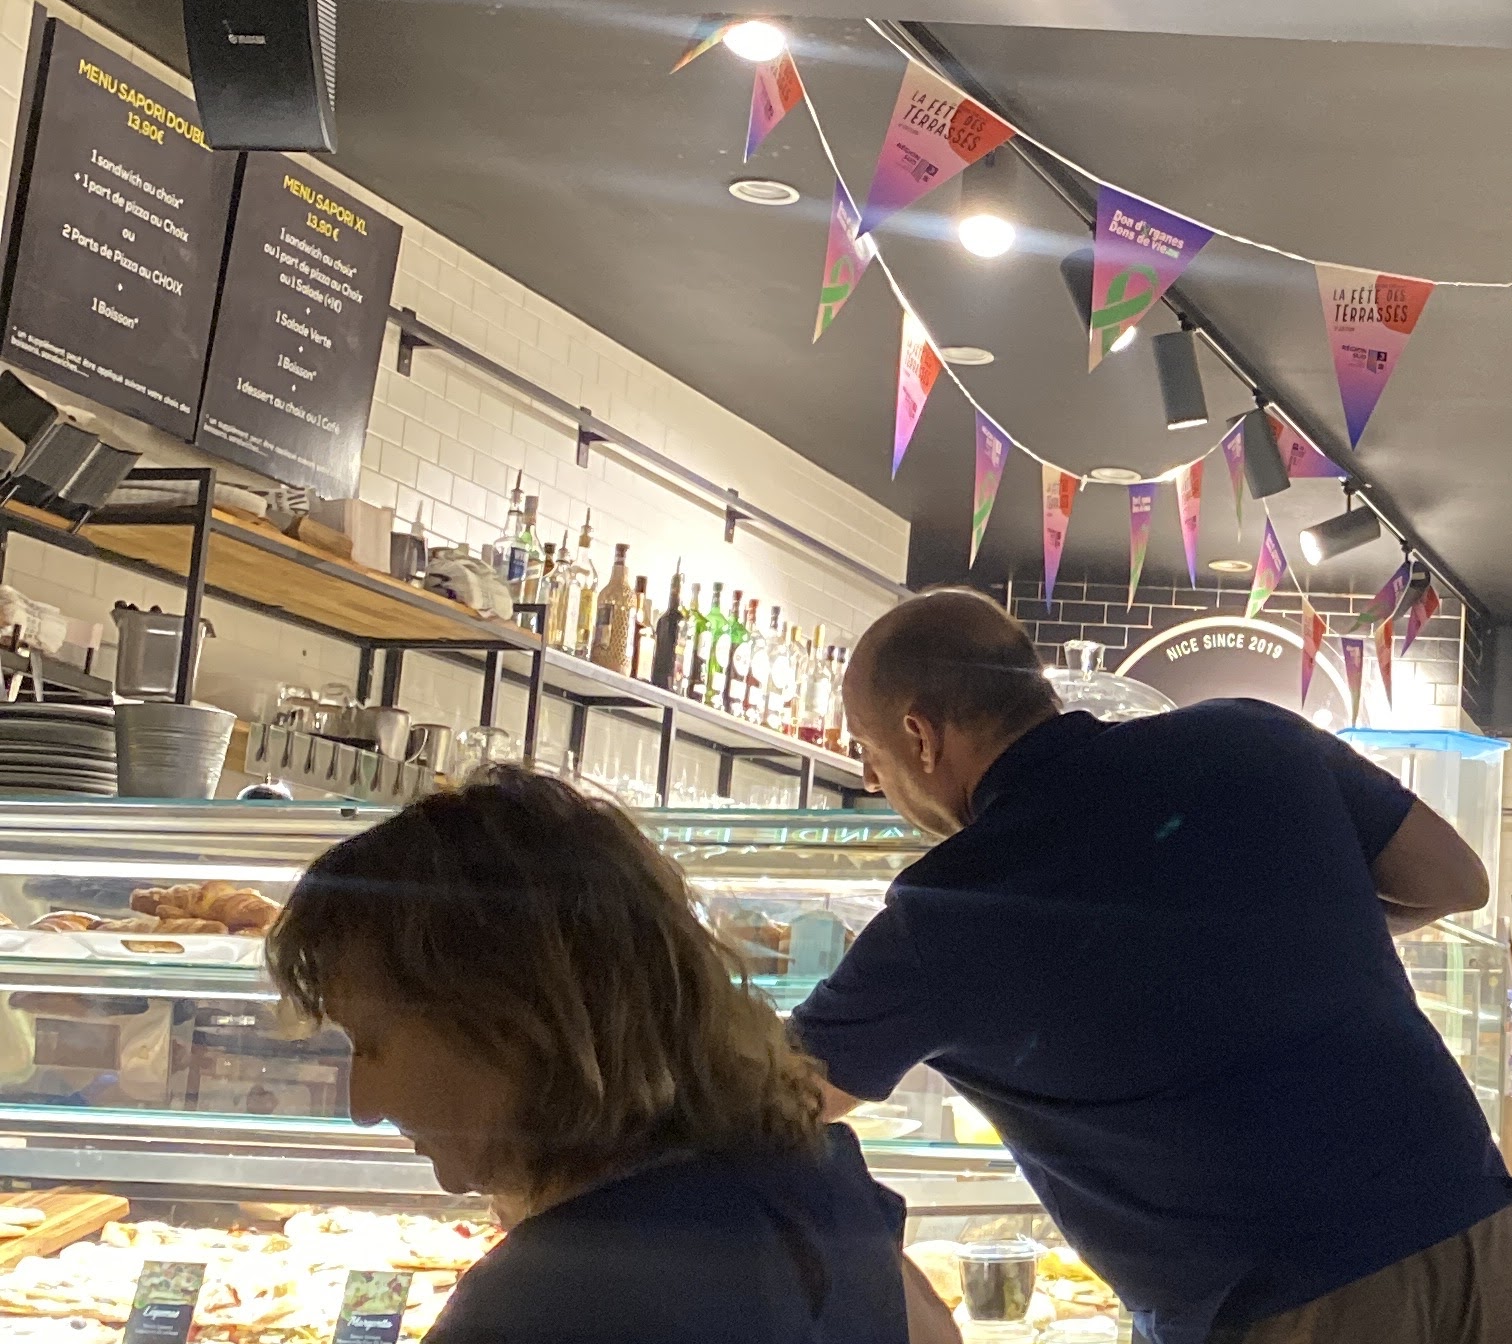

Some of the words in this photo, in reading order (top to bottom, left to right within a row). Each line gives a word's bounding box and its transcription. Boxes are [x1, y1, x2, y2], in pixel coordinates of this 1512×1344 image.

[79, 58, 118, 93] MENU
[118, 83, 166, 123] SAPORI
[166, 111, 213, 152] DOUBL
[911, 90, 927, 105] LA
[963, 115, 986, 132] DES
[903, 104, 980, 152] TERRASSES
[91, 149, 97, 162] 1
[97, 155, 142, 188] sandwich
[143, 182, 156, 196] au
[82, 174, 88, 188] 1
[88, 180, 111, 200] part
[112, 192, 125, 207] de
[125, 200, 150, 221] pizza
[150, 215, 163, 228] au
[163, 218, 190, 242] Choix
[283, 174, 317, 204] MENU
[315, 193, 355, 227] SAPORI
[354, 216, 368, 236] XL
[1113, 209, 1135, 228] Don
[122, 228, 136, 242] ou
[285, 233, 323, 261] sandwich
[322, 254, 334, 267] au
[1108, 220, 1135, 241] Dons
[1136, 234, 1150, 247] de
[62, 224, 71, 238] 2
[71, 228, 99, 253] Parts
[100, 244, 113, 259] de
[113, 250, 138, 273] Pizza
[138, 265, 152, 279] au
[151, 270, 183, 296] CHOIX
[264, 243, 276, 256] ou
[280, 252, 299, 270] part
[299, 260, 311, 275] de
[310, 268, 331, 286] pizza
[341, 283, 364, 304] Choix
[91, 297, 98, 311] 1
[295, 278, 324, 303] Salade
[1333, 289, 1345, 301] LA
[1350, 286, 1380, 305] FÊTE
[1386, 289, 1407, 302] DES
[281, 313, 309, 337] Salade
[310, 327, 332, 349] Verte
[1335, 304, 1408, 323] TERRASSES
[242, 381, 274, 405] dessert
[285, 401, 306, 421] choix
[1166, 637, 1199, 662] NICE
[1203, 633, 1245, 650] SINCE
[1248, 636, 1283, 659] 2019
